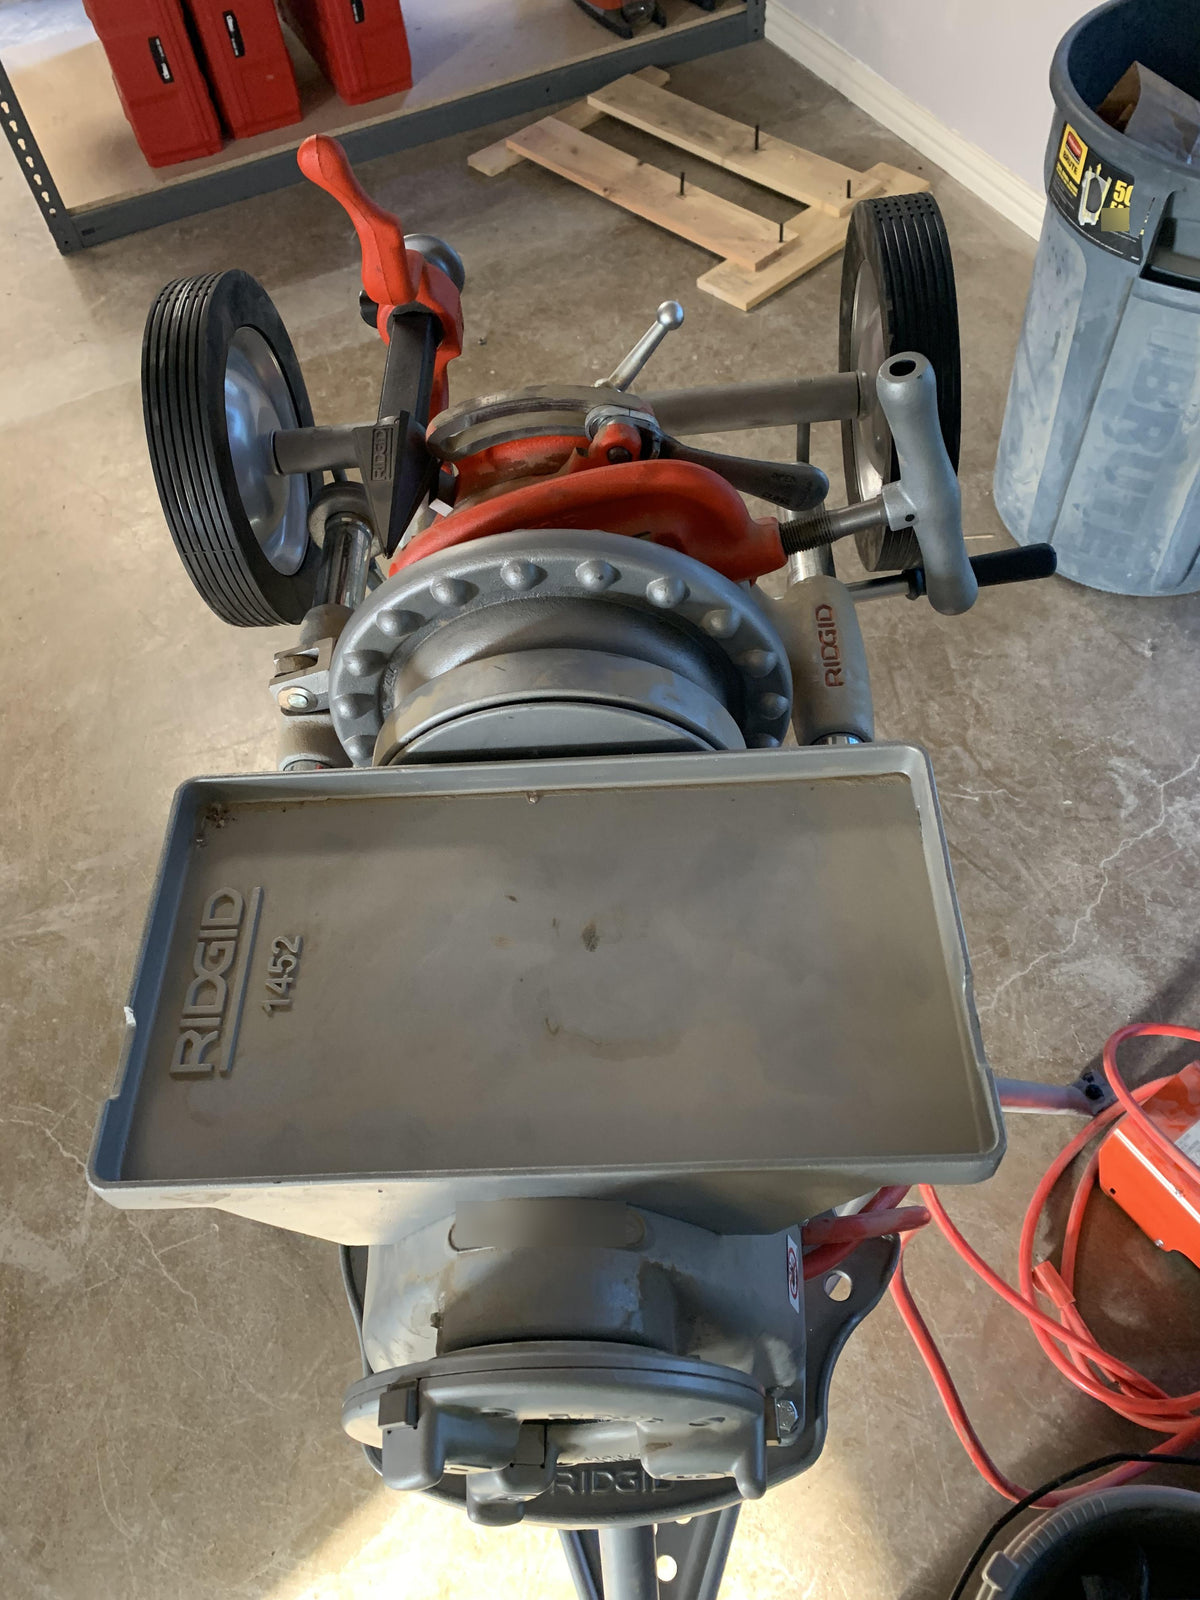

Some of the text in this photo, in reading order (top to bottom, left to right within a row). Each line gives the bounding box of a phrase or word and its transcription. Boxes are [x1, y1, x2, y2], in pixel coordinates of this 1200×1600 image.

[1063, 151, 1078, 174] BRUTE
[374, 428, 387, 480] RIDGID
[815, 604, 845, 687] RIDGID
[170, 887, 244, 1074] RIDGID
[262, 935, 303, 1016] 1452
